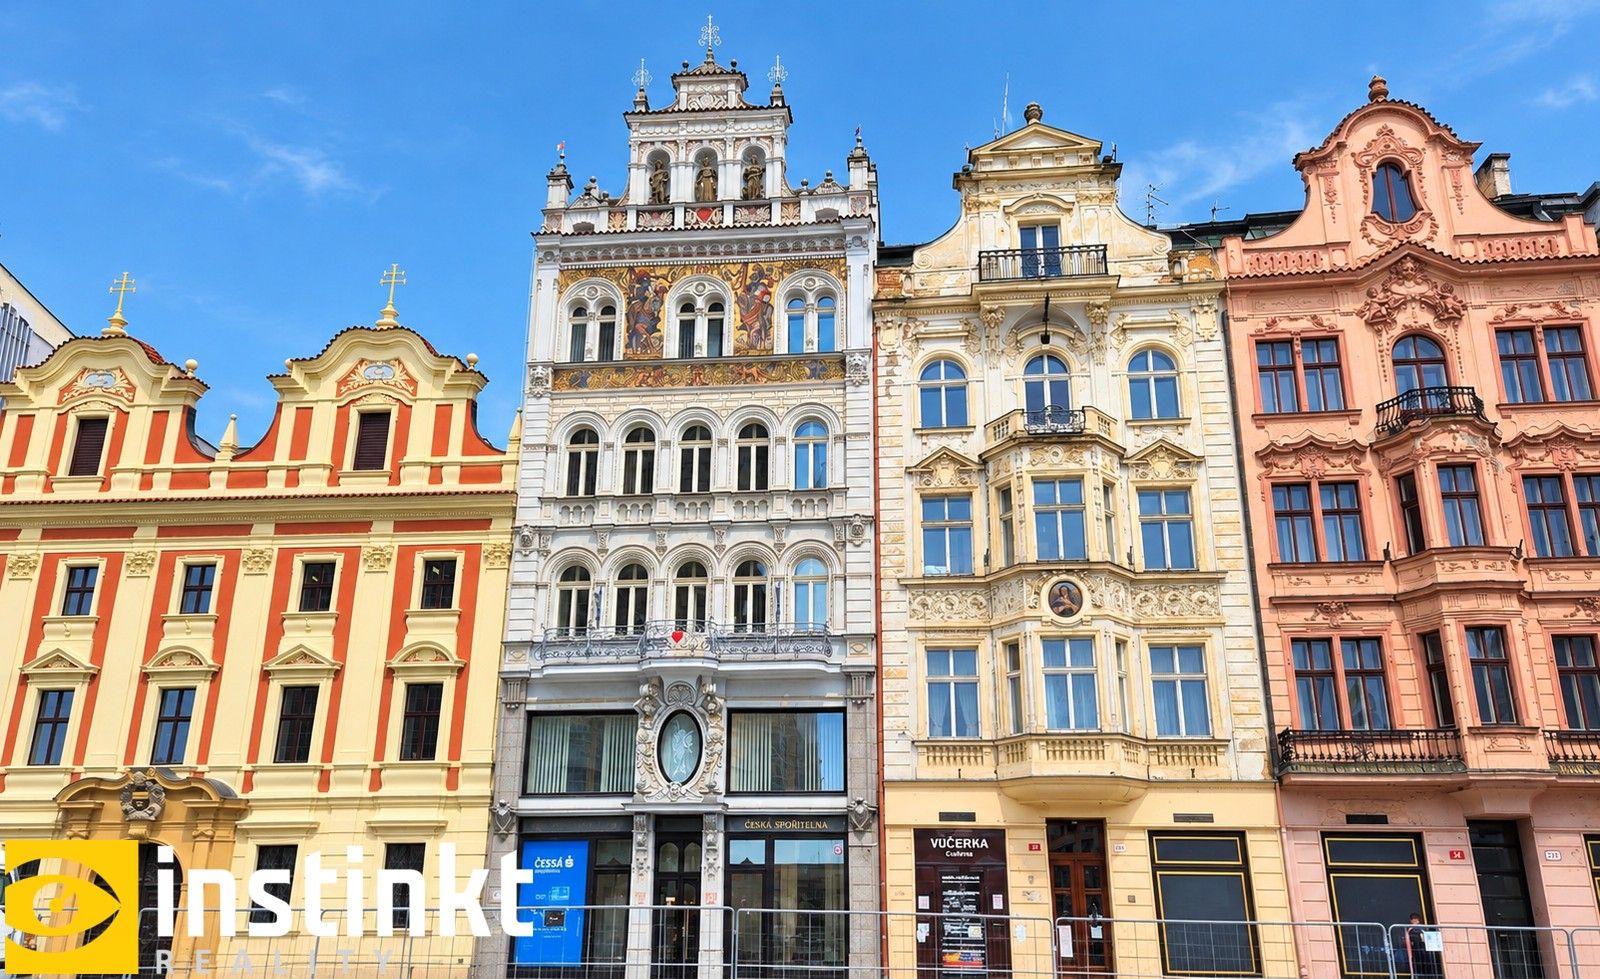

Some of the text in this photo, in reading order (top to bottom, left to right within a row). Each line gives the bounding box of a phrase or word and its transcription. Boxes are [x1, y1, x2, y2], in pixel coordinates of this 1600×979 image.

[744, 818, 828, 829] ČESKÁ SPOŘITELNA
[930, 836, 989, 849] VUČERKA
